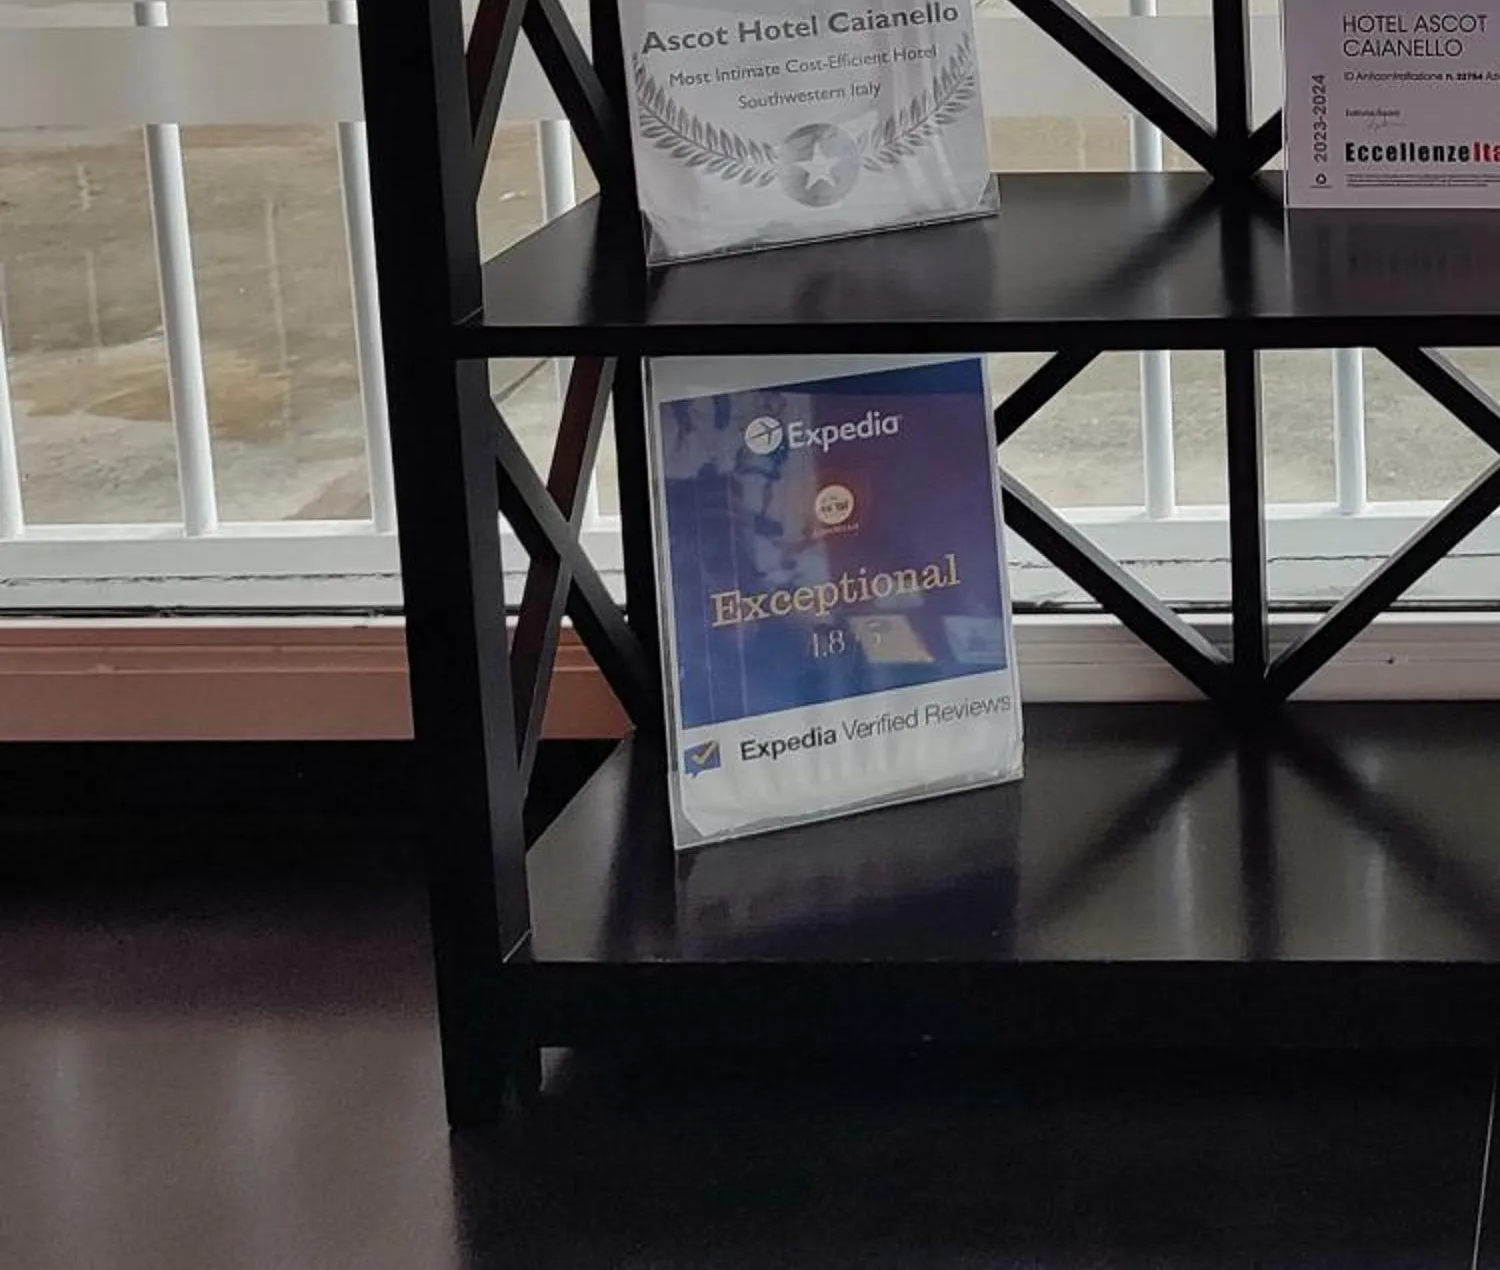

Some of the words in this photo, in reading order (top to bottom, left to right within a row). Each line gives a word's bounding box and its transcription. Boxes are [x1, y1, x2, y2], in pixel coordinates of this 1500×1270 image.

[641, 27, 729, 54] Ascot
[738, 16, 818, 43] Hotel
[828, 1, 959, 33] Caianello
[1342, 14, 1407, 33] HOTEL
[1413, 14, 1488, 33] ASCOT
[669, 71, 711, 87] Most
[715, 63, 781, 83] Intimate
[893, 44, 937, 61] Hotel
[1343, 39, 1463, 58] CAIANELLO
[738, 87, 845, 110] Southwestern
[851, 82, 881, 99] Italy
[1311, 74, 1328, 163] 2023-2024
[787, 411, 900, 452] Expedia
[711, 554, 961, 628] Exceptional
[740, 726, 837, 761] Expedia
[841, 709, 919, 741] Verified
[924, 694, 1012, 725] Reviews
